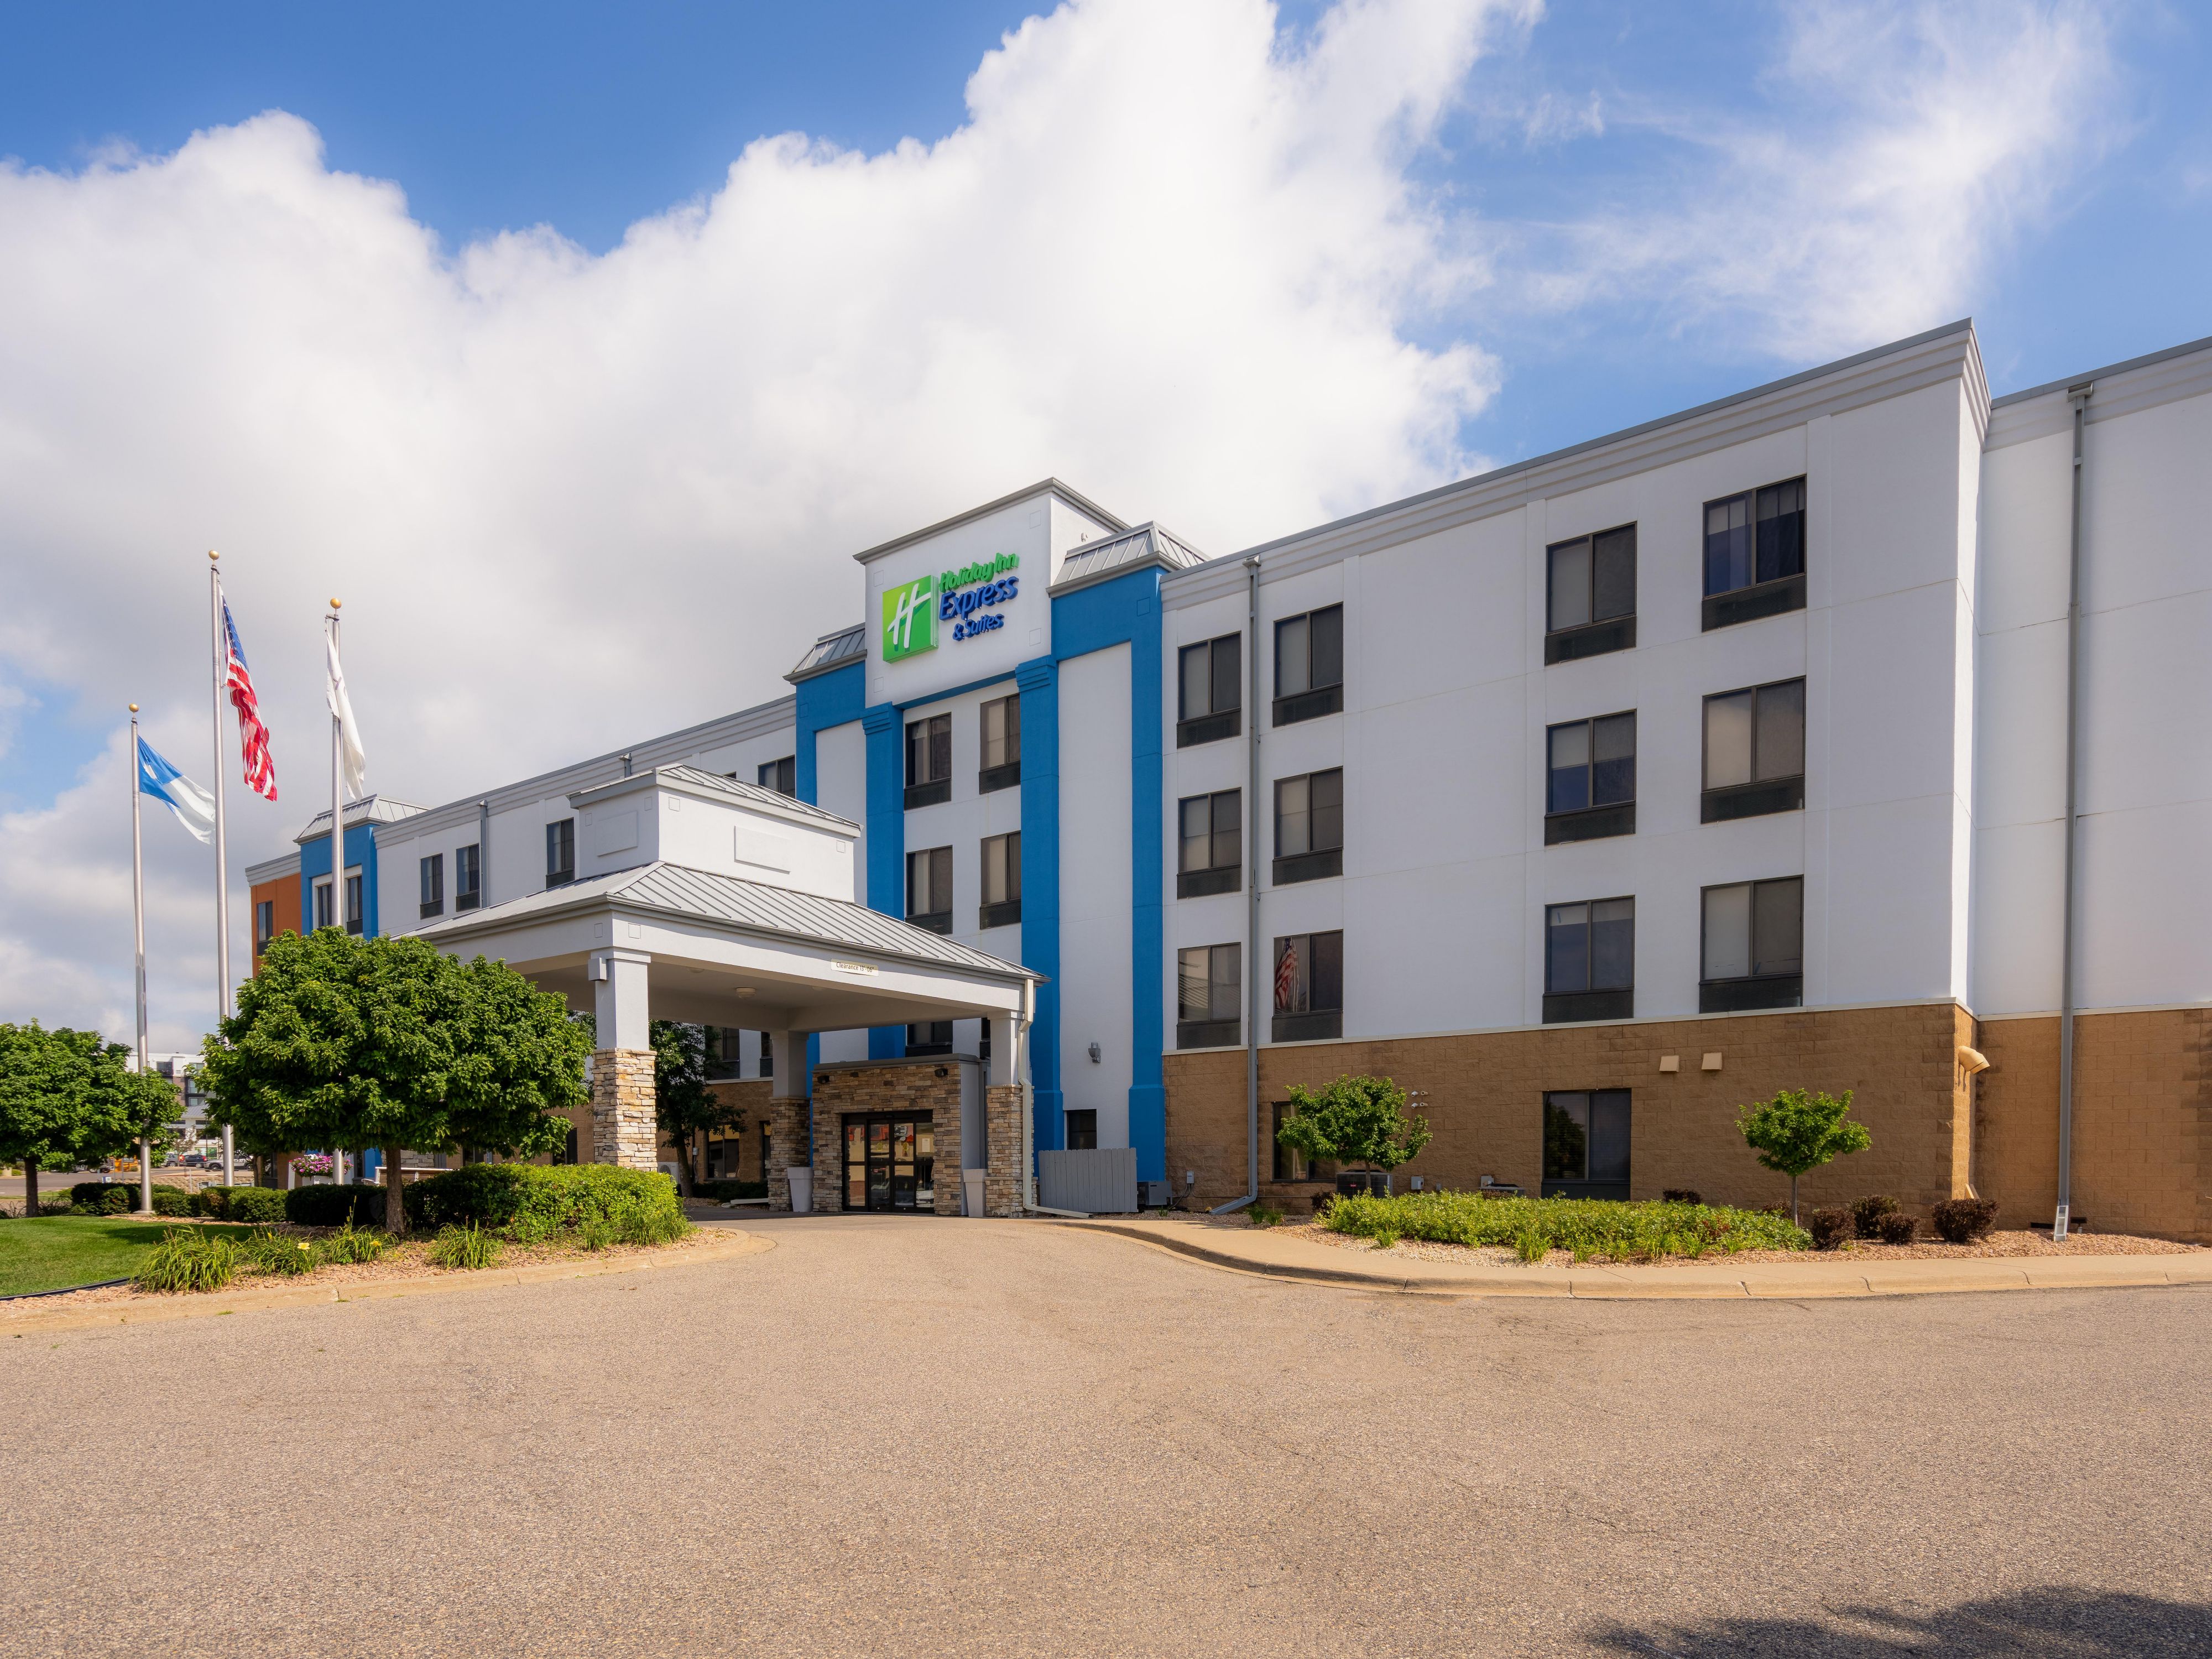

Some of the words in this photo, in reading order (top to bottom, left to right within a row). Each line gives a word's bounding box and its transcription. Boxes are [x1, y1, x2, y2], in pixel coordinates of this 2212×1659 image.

[939, 562, 995, 593] Holiday
[994, 552, 1020, 573] Inn
[939, 576, 1019, 620] Express
[952, 623, 965, 641] &
[963, 613, 1004, 638] Suites
[836, 962, 858, 971] Clearance
